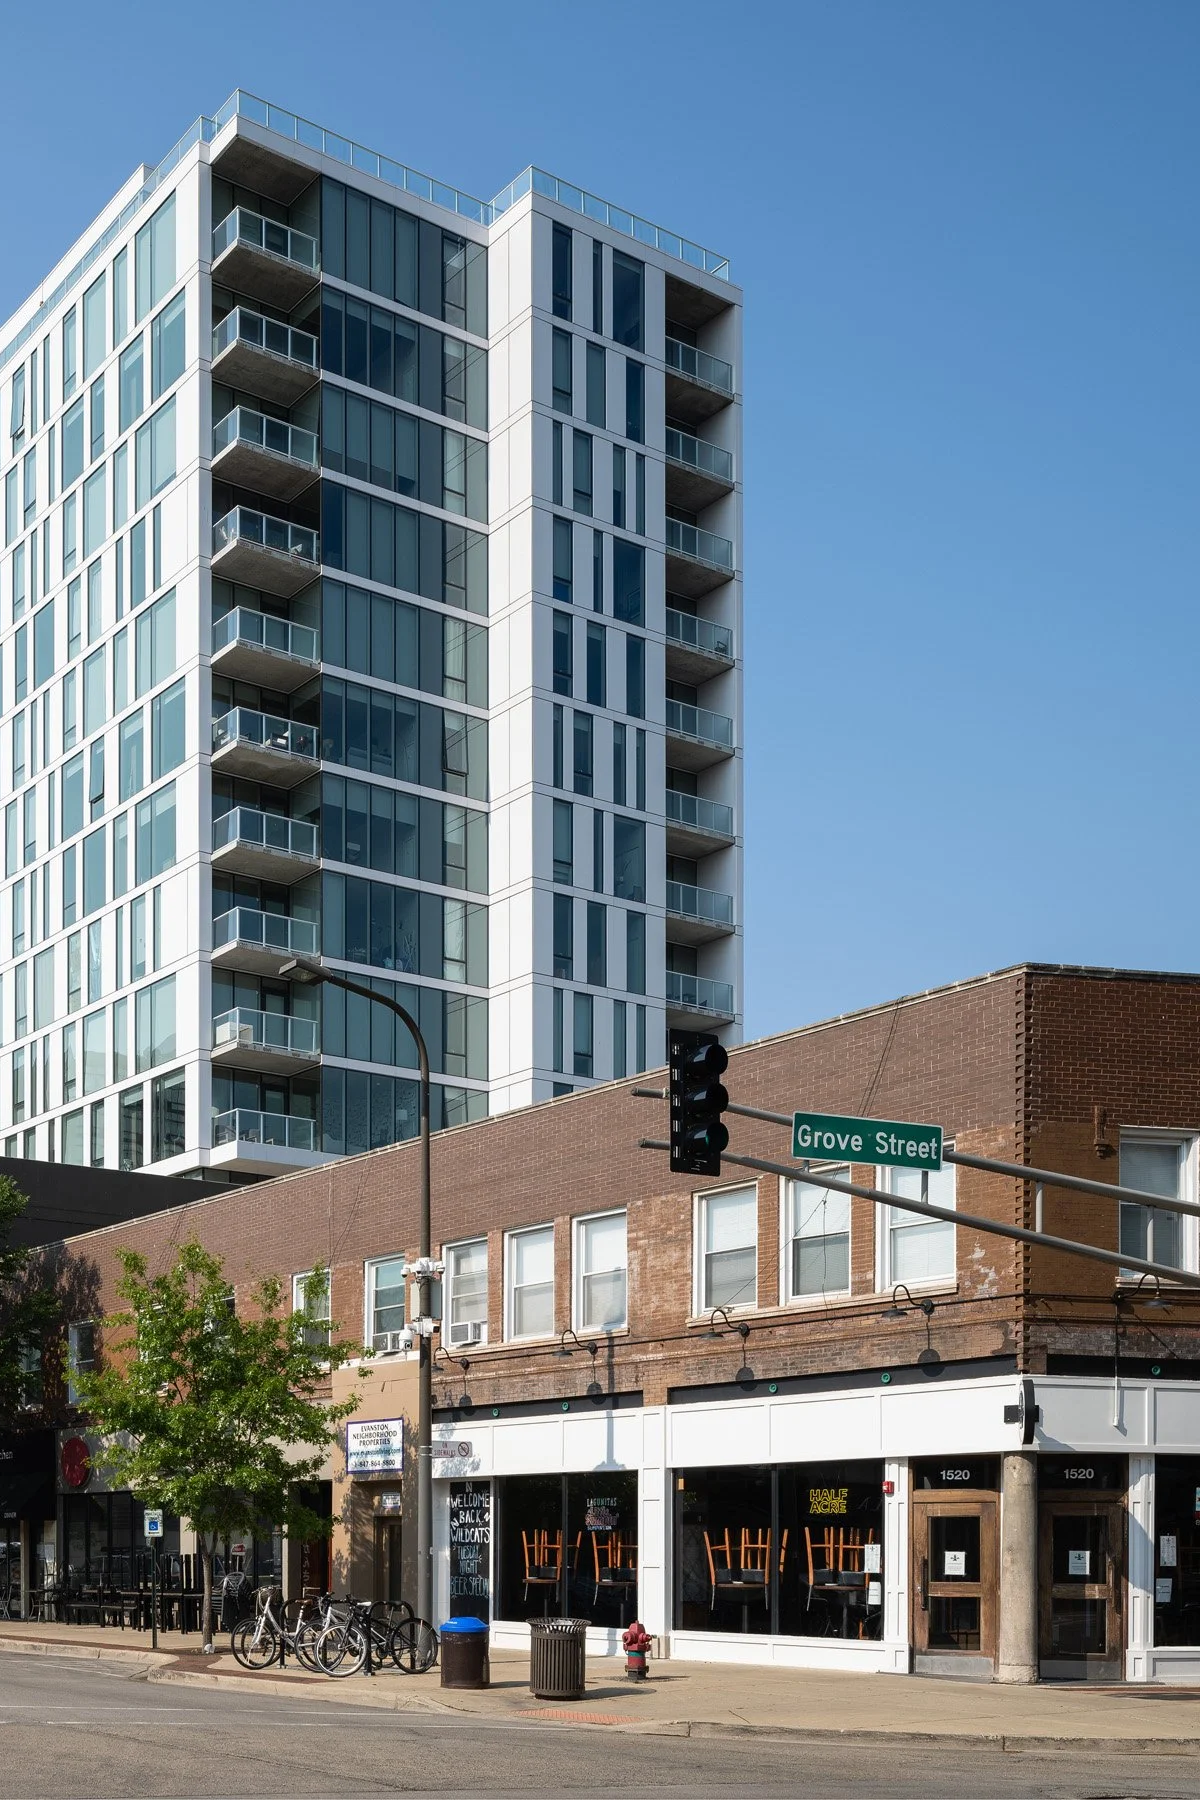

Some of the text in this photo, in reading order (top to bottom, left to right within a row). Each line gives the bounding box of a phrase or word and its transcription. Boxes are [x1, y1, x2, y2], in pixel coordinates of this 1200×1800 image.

[797, 1125, 938, 1160] Grove Street
[361, 1423, 389, 1432] EVANSTON
[352, 1430, 398, 1440] NEIGHBORHOOD
[359, 1438, 391, 1446] PROPERTIES
[940, 1469, 971, 1480] 1520
[1063, 1468, 1095, 1479] 1520
[809, 1488, 849, 1501] HALF
[450, 1493, 490, 1508] WELCOME
[586, 1497, 617, 1507] LAGUNITAS
[809, 1501, 848, 1513] ACRE
[459, 1509, 481, 1524] BACK
[450, 1527, 491, 1543] WILDCATS
